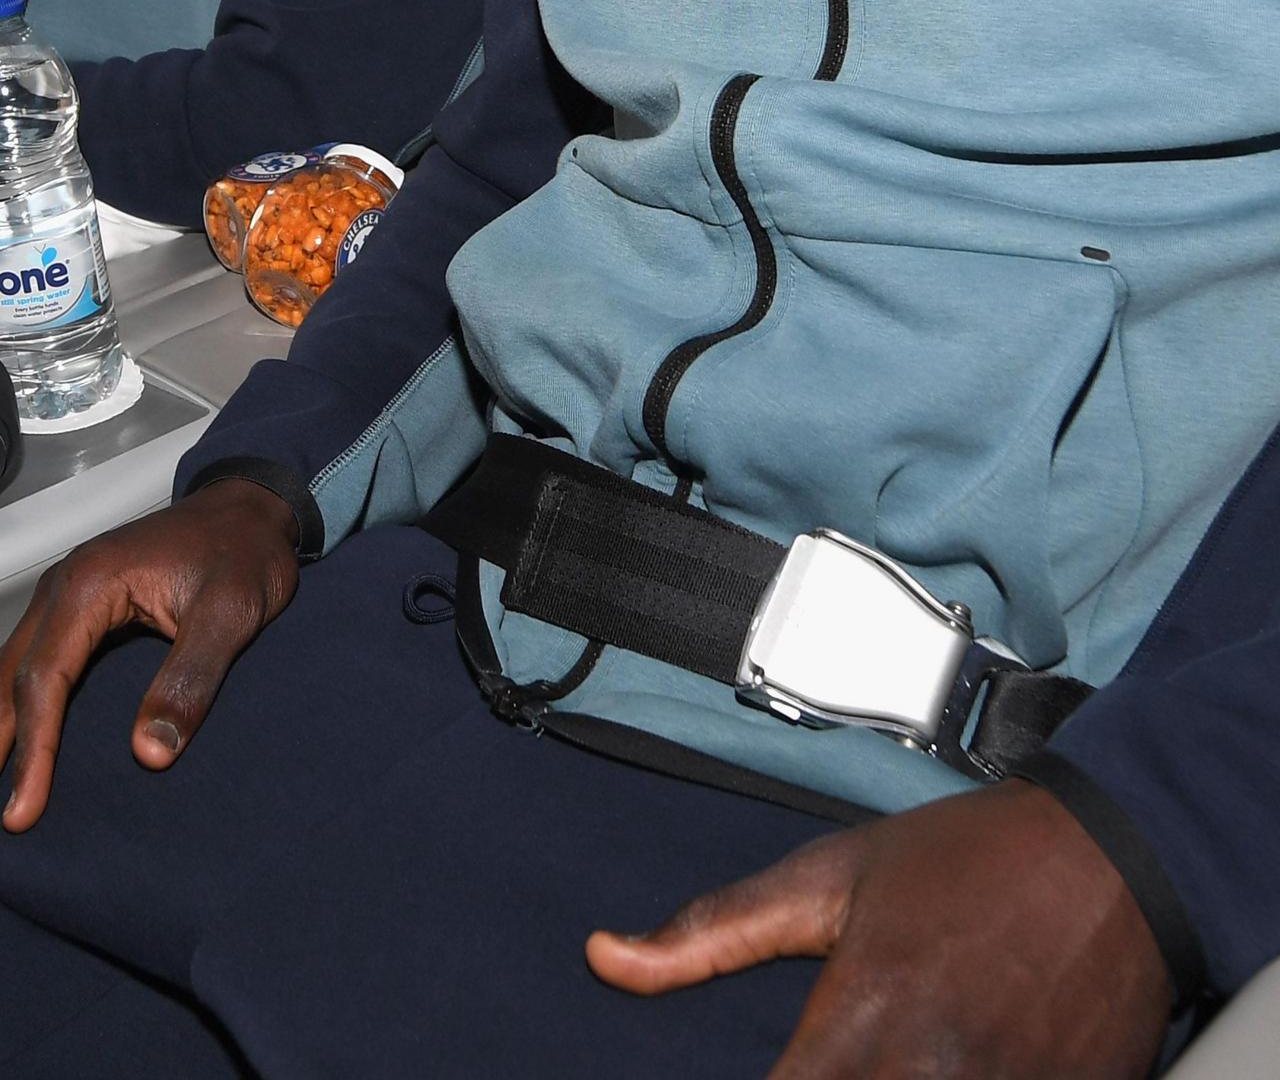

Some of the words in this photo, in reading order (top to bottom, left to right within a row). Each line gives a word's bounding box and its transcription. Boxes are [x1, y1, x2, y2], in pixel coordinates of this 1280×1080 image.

[343, 213, 379, 251] CHELSEA
[17, 295, 44, 307] spring
[47, 288, 71, 300] water
